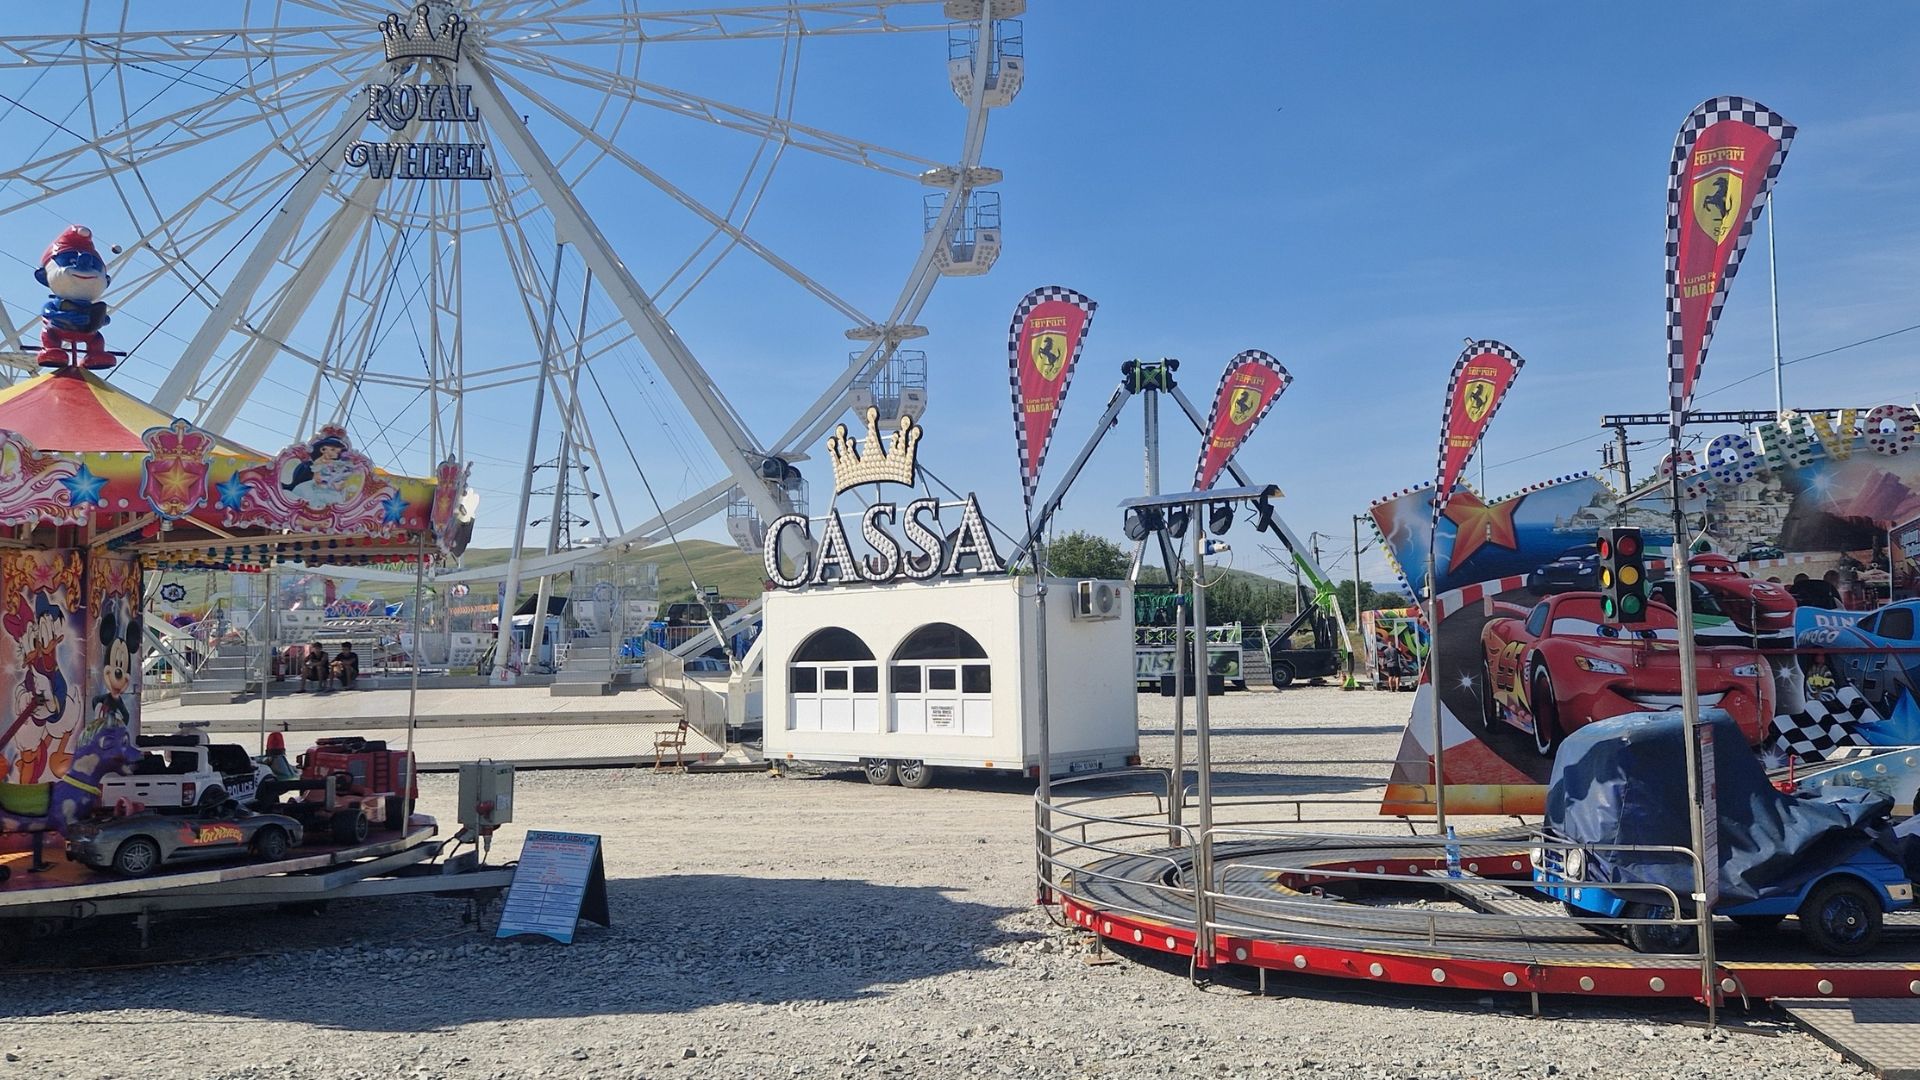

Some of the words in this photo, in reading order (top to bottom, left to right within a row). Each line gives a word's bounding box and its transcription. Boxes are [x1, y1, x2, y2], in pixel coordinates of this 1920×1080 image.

[367, 84, 479, 130] ROYAL
[344, 140, 492, 180] WHEEL
[1693, 146, 1745, 167] Ferrari
[1030, 316, 1067, 329] Ferrari
[1658, 403, 1920, 503] CONVO
[762, 492, 1007, 589] CASSA
[227, 781, 254, 797] POLICE
